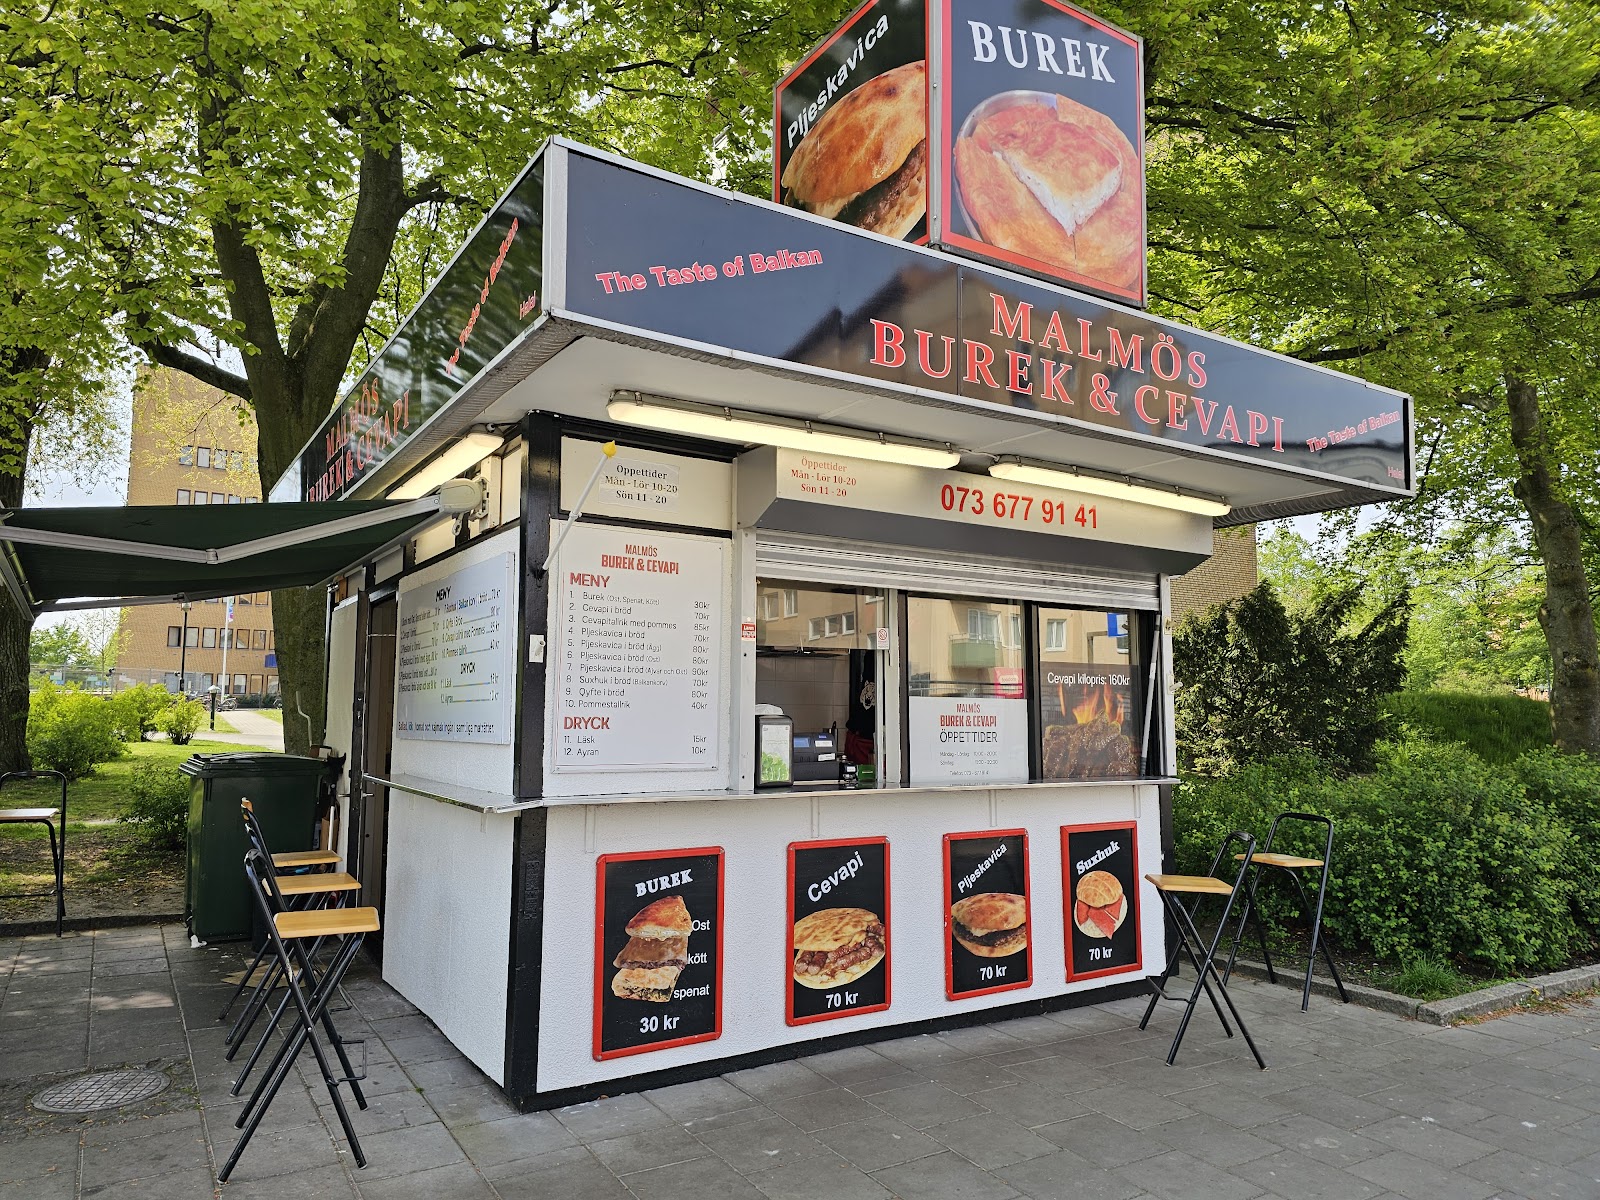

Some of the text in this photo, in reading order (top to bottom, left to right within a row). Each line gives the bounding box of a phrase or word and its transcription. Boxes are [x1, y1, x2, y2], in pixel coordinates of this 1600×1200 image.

[967, 20, 1115, 83] BUREK
[787, 14, 890, 149] Pljeskavica
[595, 248, 823, 294] The Taste of Balkan
[990, 292, 1207, 389] MALMÖS
[869, 318, 1285, 454] BUREK & CEVAPI
[326, 377, 379, 464] MALMÖS
[1306, 410, 1400, 453] The Taste of Balkan
[309, 389, 410, 502] BUREK & CEVAPI
[801, 455, 847, 473] Öppettider
[605, 475, 625, 487] Mån
[633, 479, 649, 490] Lör
[652, 483, 677, 494] 10-20
[791, 469, 809, 479] Mån
[817, 471, 831, 482] Lör
[833, 475, 857, 486] 10-20
[615, 489, 633, 501] Sön
[636, 493, 647, 503] 11
[656, 494, 667, 504] 20
[801, 482, 817, 494] Sön
[819, 486, 829, 495] 11
[836, 487, 847, 498] 20
[941, 484, 1096, 528] 073 677 91 41
[625, 544, 658, 557] MALMÖS
[602, 554, 679, 574] BUREK & CEVAPI
[570, 572, 610, 588] MENY
[435, 586, 451, 602] MENY
[583, 592, 605, 600] Burek
[694, 601, 710, 609] 30kr
[582, 604, 608, 614] Cevapi
[615, 606, 632, 614] bröd
[647, 621, 677, 629] pommes
[581, 628, 622, 638] Pljeskavica
[629, 631, 645, 639] bröd
[568, 639, 574, 647] 5.
[629, 643, 645, 651] bröd
[580, 651, 622, 661] Pljeskavica
[628, 654, 644, 662] bröd
[460, 662, 476, 675] DRYCK
[567, 663, 573, 671] 7.
[614, 677, 631, 685] bröd
[1047, 672, 1130, 687] Cevapi kilopris: 160kr
[579, 688, 601, 697] Qyfte
[565, 700, 575, 708] 10.
[691, 702, 707, 710] 40kr
[957, 703, 981, 713] MALMÖS
[564, 717, 610, 730] DRYCK
[940, 715, 996, 727] BUREK & CEVAPI
[940, 729, 997, 742] ÖPPETTIDER
[577, 748, 599, 757] Ayran
[1076, 840, 1120, 875] Suxhuk
[958, 843, 1007, 893] Pljeskavica
[635, 868, 693, 898] BUREK
[808, 851, 865, 902] Cevapi
[692, 920, 710, 931] Ost
[688, 952, 708, 964] kött
[1089, 947, 1112, 961] 70 kr
[980, 965, 1007, 980] 70 kr
[674, 984, 710, 1000] spenat
[826, 991, 858, 1009] 70 kr
[640, 1014, 680, 1033] 30 kr
